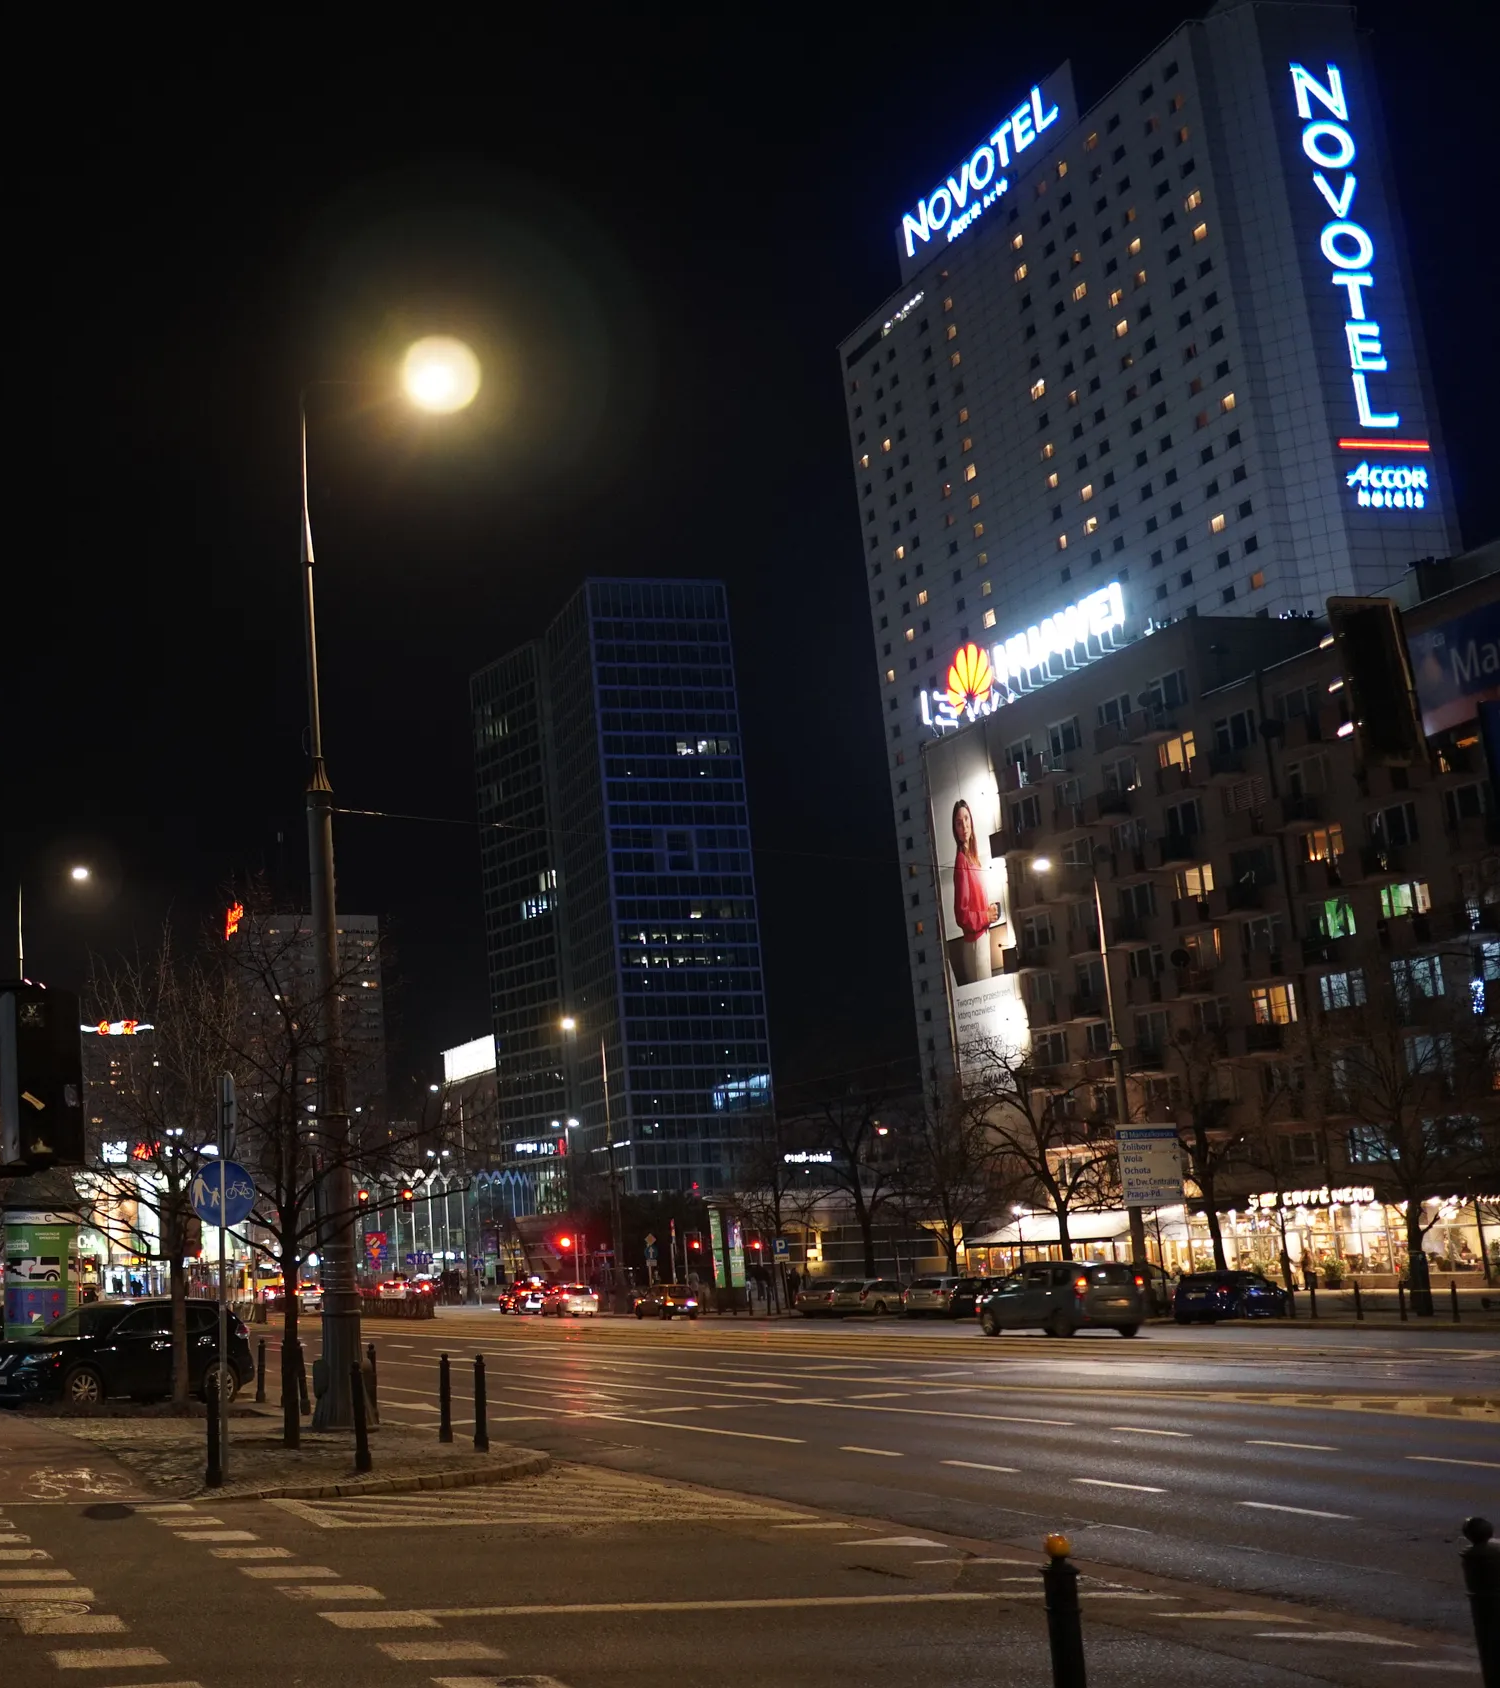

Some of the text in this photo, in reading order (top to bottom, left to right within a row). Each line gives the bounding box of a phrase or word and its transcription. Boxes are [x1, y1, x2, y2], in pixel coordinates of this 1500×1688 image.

[902, 83, 1060, 258] NOVOTEL
[1289, 61, 1399, 428] NOVOTEL
[1449, 638, 1500, 686] Ma
[1123, 1155, 1143, 1163] Wola
[1124, 1167, 1151, 1175] Ochota
[1331, 1185, 1375, 1203] NERO
